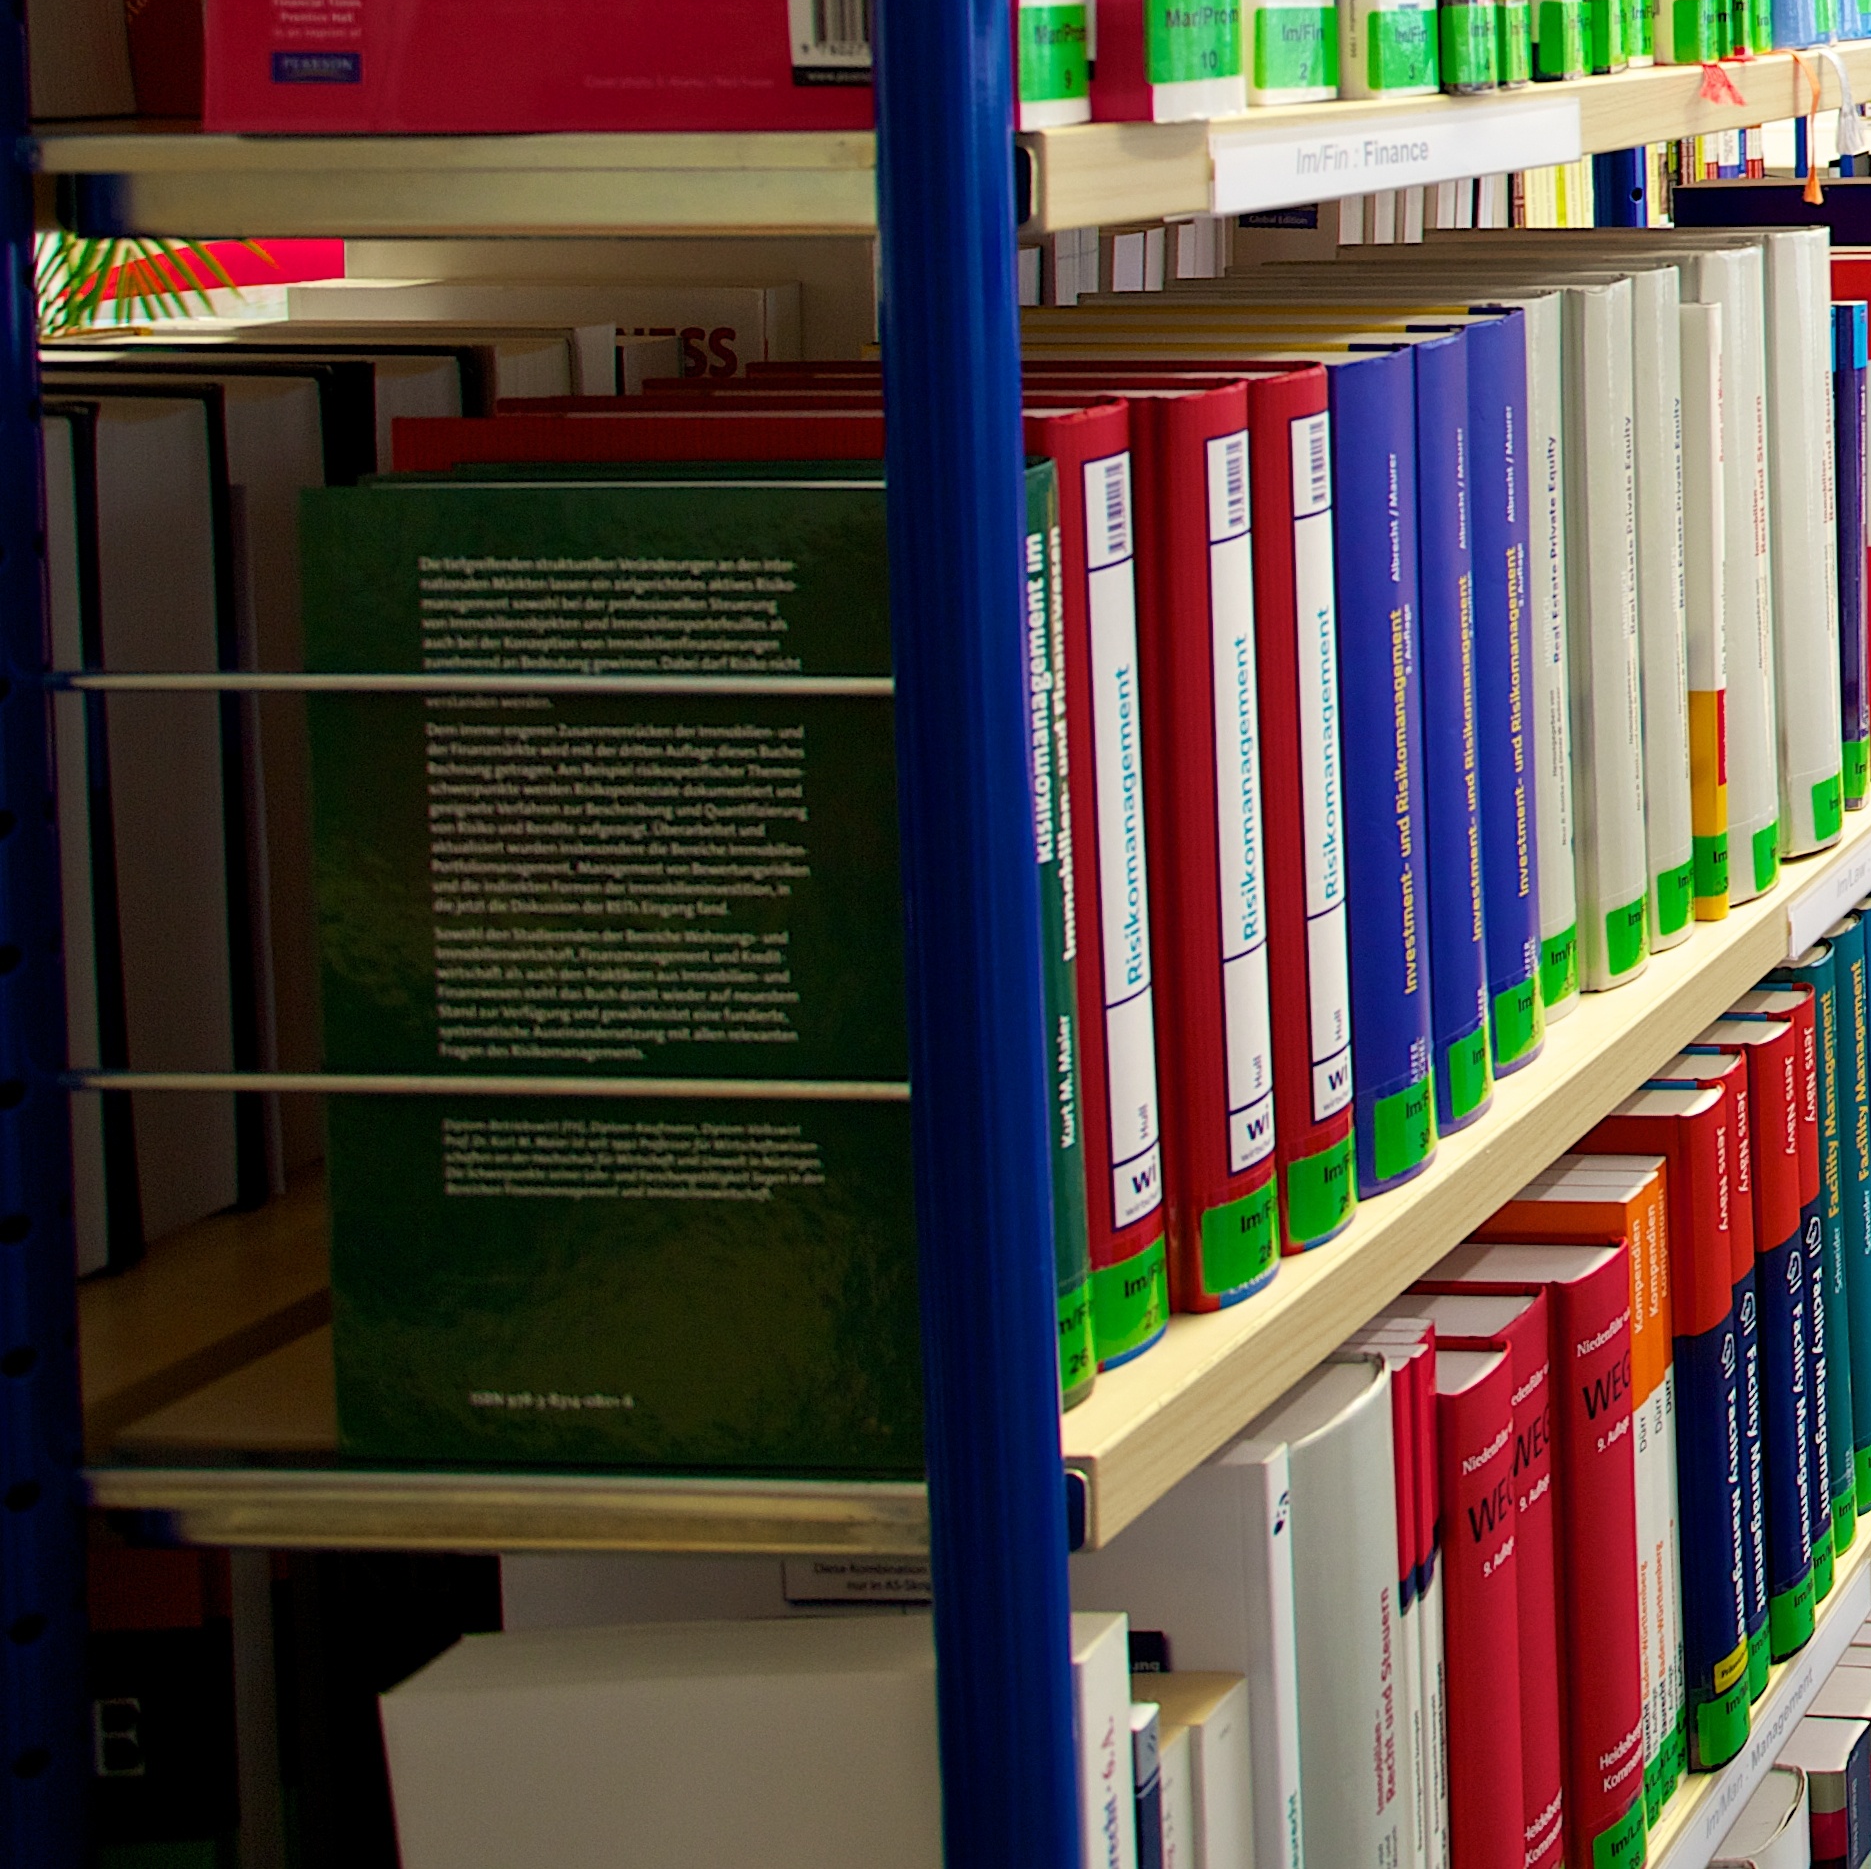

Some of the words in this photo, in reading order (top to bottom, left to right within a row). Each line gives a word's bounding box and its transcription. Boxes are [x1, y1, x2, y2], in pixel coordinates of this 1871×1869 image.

[1063, 68, 1072, 90] 9
[1200, 49, 1218, 71] 10
[1297, 62, 1310, 81] 2
[1408, 63, 1418, 82] 3
[1296, 144, 1351, 175] Im/Fin
[1363, 137, 1430, 168] Finance
[1503, 405, 1514, 454] Maurer
[1624, 416, 1633, 471] Equity
[1385, 452, 1398, 504] Maurer
[1547, 435, 1557, 492] Equity
[1505, 470, 1517, 524] Albrecht
[1388, 524, 1403, 584] Albrecht
[1549, 495, 1559, 567] Private
[1506, 546, 1523, 737] Risikomanagement
[1457, 575, 1476, 776] Risikomanagement
[1390, 608, 1411, 812] Risikomanagement
[1316, 605, 1340, 901] Risikomanagement
[1511, 741, 1524, 776] und
[1233, 633, 1263, 942] Risikomanagement
[1466, 781, 1478, 815] und
[1112, 663, 1148, 987] Risikomanagement
[1397, 815, 1413, 858] und
[1513, 778, 1531, 900] Investment-
[1466, 820, 1483, 943] Investment-
[1400, 864, 1418, 996] Investment-
[1332, 1008, 1343, 1042] Hull
[1803, 1026, 1813, 1070] Jens
[1850, 958, 1867, 1100] Management
[1252, 1054, 1264, 1090] Hull
[1327, 1059, 1351, 1094] wi
[1784, 1056, 1795, 1097] Jens
[1818, 990, 1839, 1135] Management
[1138, 1102, 1151, 1142] Hull
[1245, 1108, 1272, 1144] wi
[1736, 1090, 1747, 1135] Jens
[1716, 1125, 1728, 1175] Jens
[1857, 1105, 1869, 1183] Facility
[1130, 1155, 1159, 1196] wi
[1827, 1139, 1840, 1219] Facility
[1790, 1302, 1805, 1394] Facility
[1653, 1396, 1662, 1435] Dürr
[1743, 1343, 1758, 1438] Facility
[1638, 1415, 1649, 1454] Dürr
[1725, 1384, 1738, 1483] Facility
[1813, 1359, 1832, 1520] Management
[1794, 1396, 1811, 1564] Management
[1746, 1439, 1766, 1613] Management
[1750, 1668, 1816, 1768] Management
